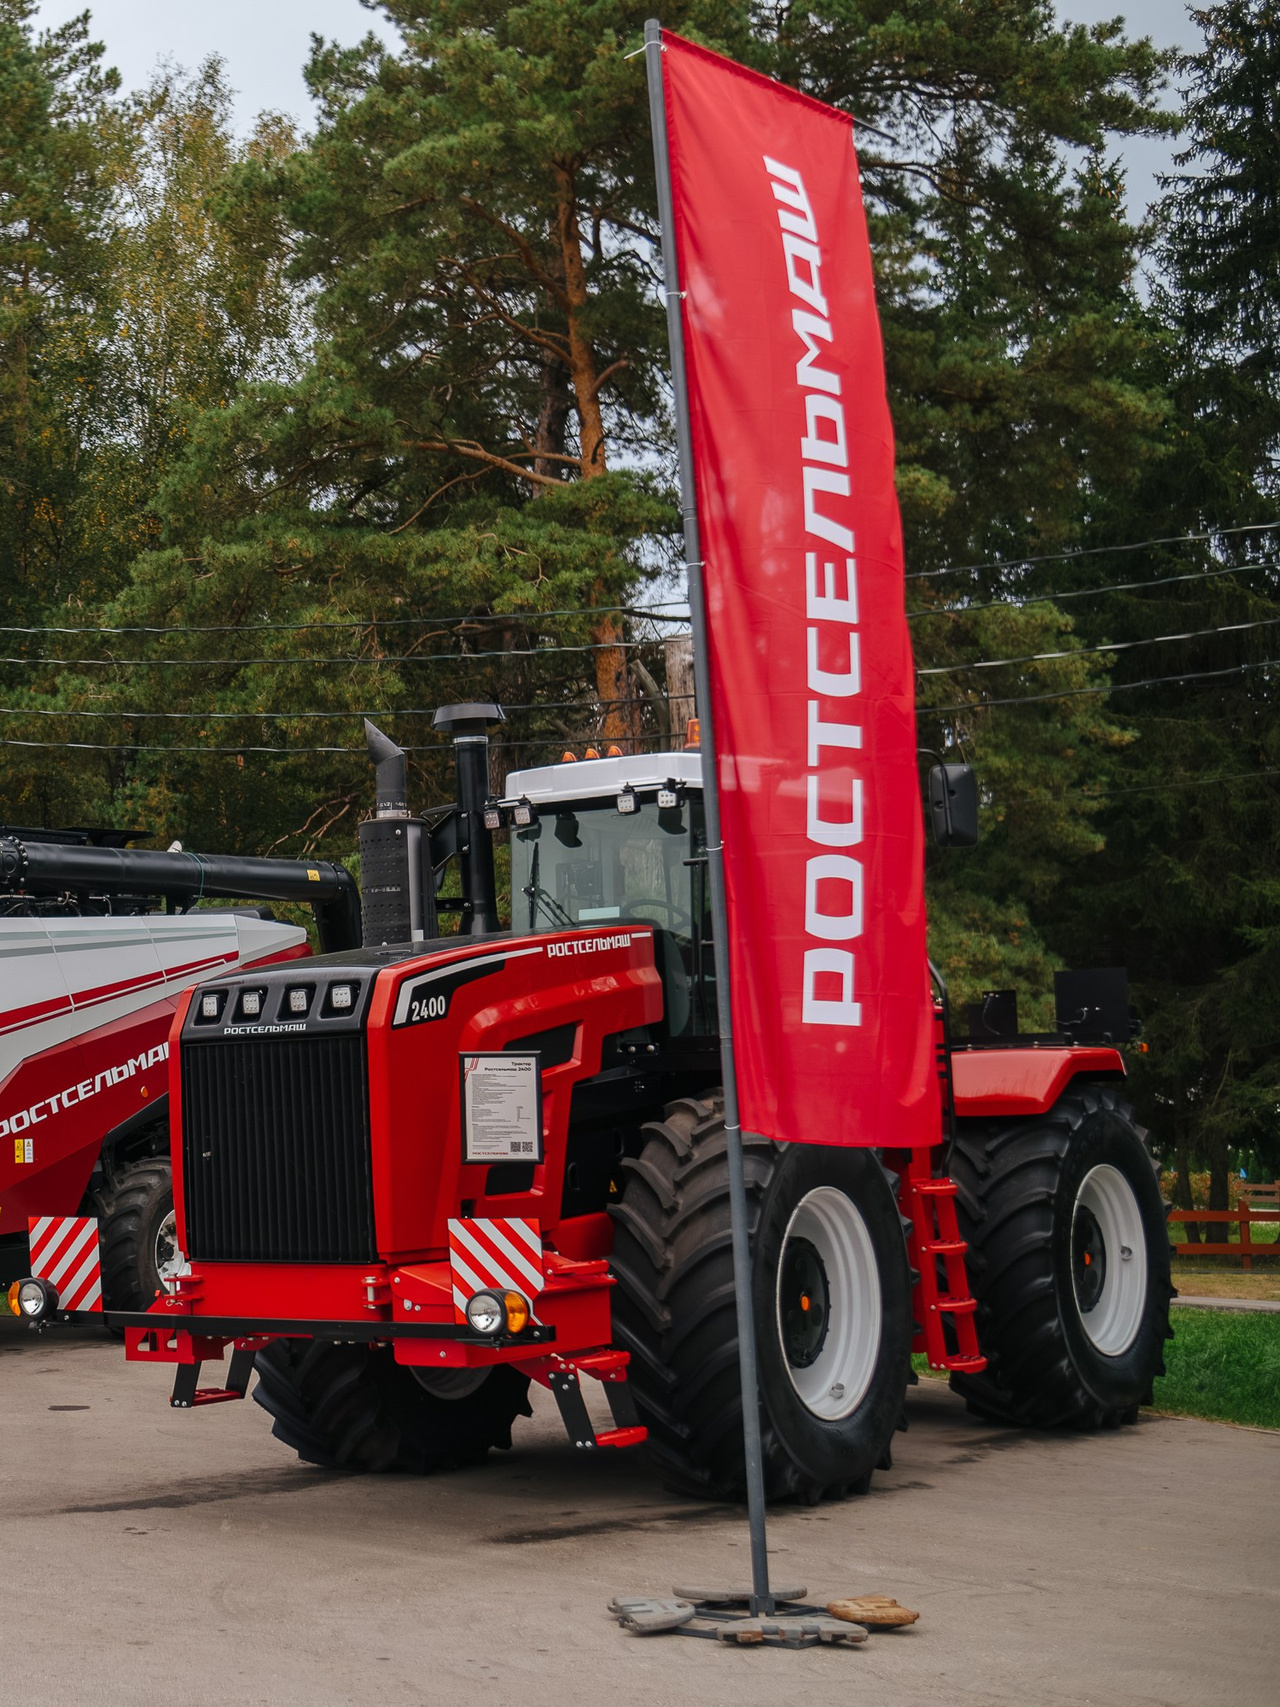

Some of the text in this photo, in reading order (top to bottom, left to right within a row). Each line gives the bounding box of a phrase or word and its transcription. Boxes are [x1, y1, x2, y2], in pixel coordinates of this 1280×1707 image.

[763, 155, 864, 1028] РОСТСЕЛЬМАШ
[546, 933, 631, 958] РОСТСЕЛЬМАШ
[411, 995, 445, 1022] 2400
[223, 1023, 307, 1035] РОСТСЕЛЬМАШ
